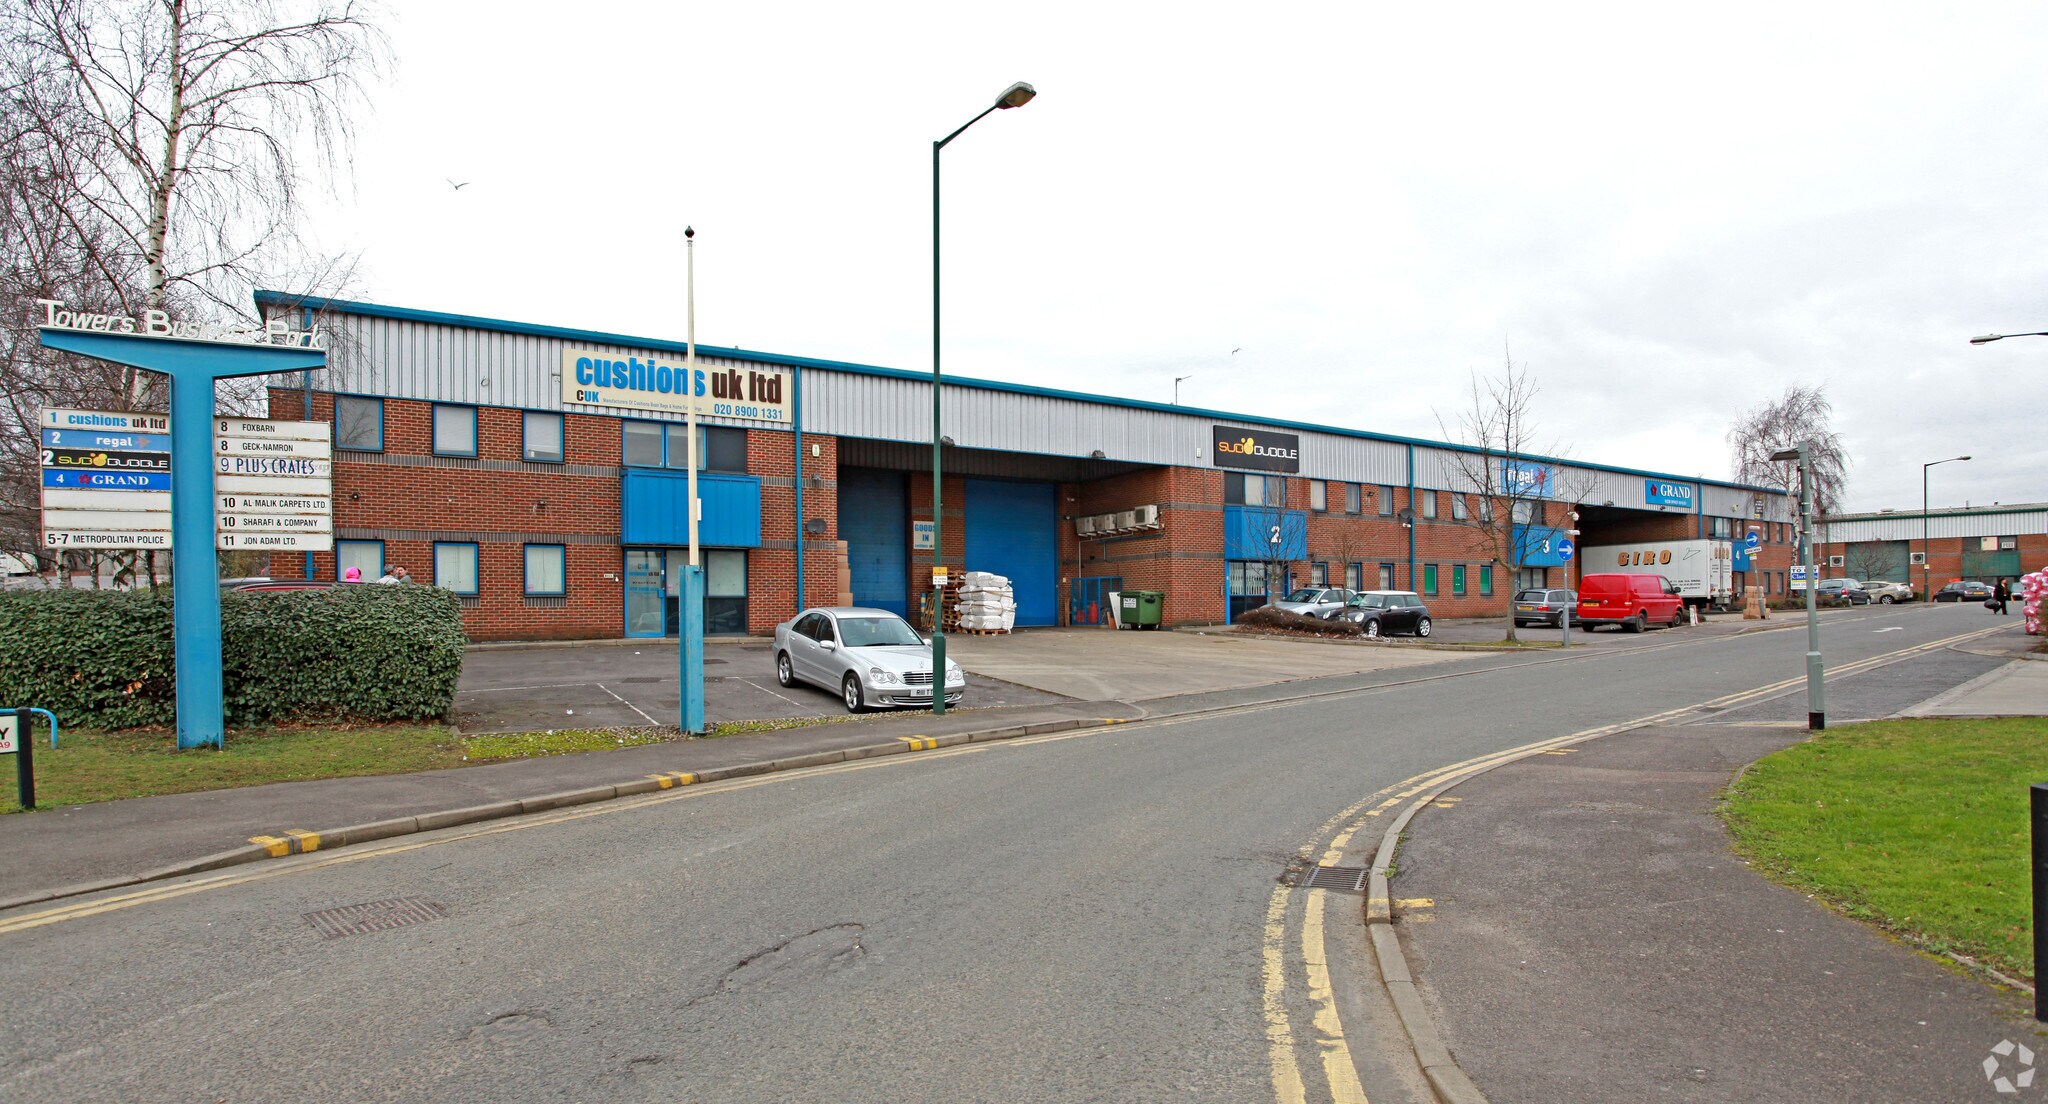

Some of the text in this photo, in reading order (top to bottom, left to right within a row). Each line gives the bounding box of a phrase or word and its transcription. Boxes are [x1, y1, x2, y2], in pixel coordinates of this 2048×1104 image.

[37, 299, 136, 333] Towers
[266, 319, 325, 349] Park
[576, 356, 782, 404] cushions uk ltd
[576, 390, 600, 403] CUK
[714, 404, 783, 419] 020 8900 1331
[50, 411, 166, 429] 1 cushions uk ltd
[220, 421, 275, 432] 8 FOXBARN
[52, 431, 133, 447] 2 regal
[221, 440, 293, 452] 8 GECK-NAMRON
[42, 450, 54, 466] 2
[221, 457, 229, 471] 9
[236, 458, 268, 473] PLUS
[271, 458, 315, 474] CRATES
[56, 474, 149, 485] 4 GRAND
[1660, 484, 1691, 498] GRAND
[222, 497, 236, 508] 10
[243, 499, 252, 507] AL
[279, 500, 311, 508] CARPETS
[222, 516, 236, 527] 10
[243, 518, 274, 526] SHARAFI
[284, 519, 318, 527] COMPANY
[915, 524, 934, 532] GOOD
[48, 533, 164, 545] 5-7 METROPOLITAN POLICE
[223, 535, 297, 546] 11 JON ADAM LTD.
[1271, 525, 1282, 543] 2
[1543, 539, 1550, 554] 3
[1735, 550, 1740, 560] 4
